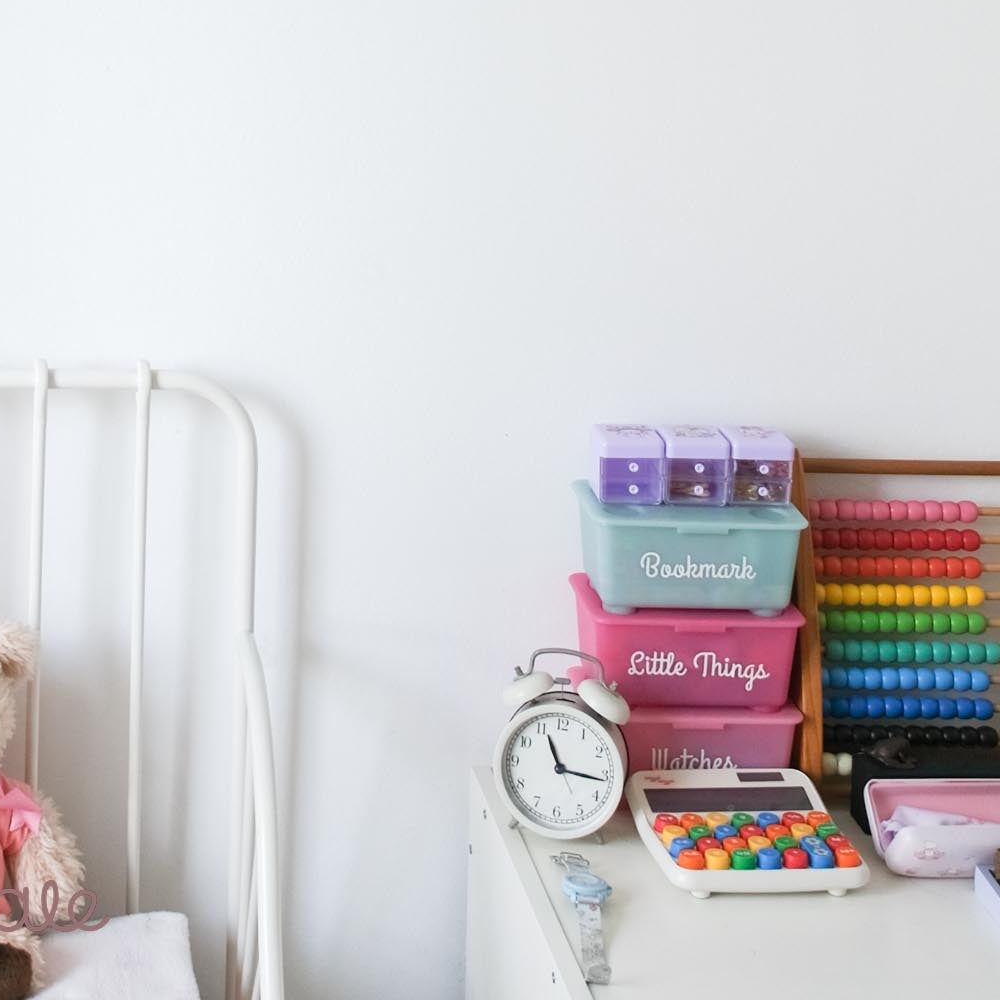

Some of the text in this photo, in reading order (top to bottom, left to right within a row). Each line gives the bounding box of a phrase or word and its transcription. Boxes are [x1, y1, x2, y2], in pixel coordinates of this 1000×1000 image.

[640, 552, 756, 580] Bookmark
[628, 651, 770, 691] Little Things
[537, 722, 546, 735] 11
[557, 718, 569, 731] 12
[581, 728, 585, 740] 1
[520, 735, 532, 748] 10
[595, 746, 603, 758] 2
[652, 748, 738, 769] Watches
[511, 755, 519, 767] 9
[601, 769, 609, 781] 3
[516, 778, 525, 790] 8
[533, 795, 541, 808] 7
[591, 790, 599, 802] 4
[552, 805, 561, 818] 6
[575, 803, 584, 816] 5
